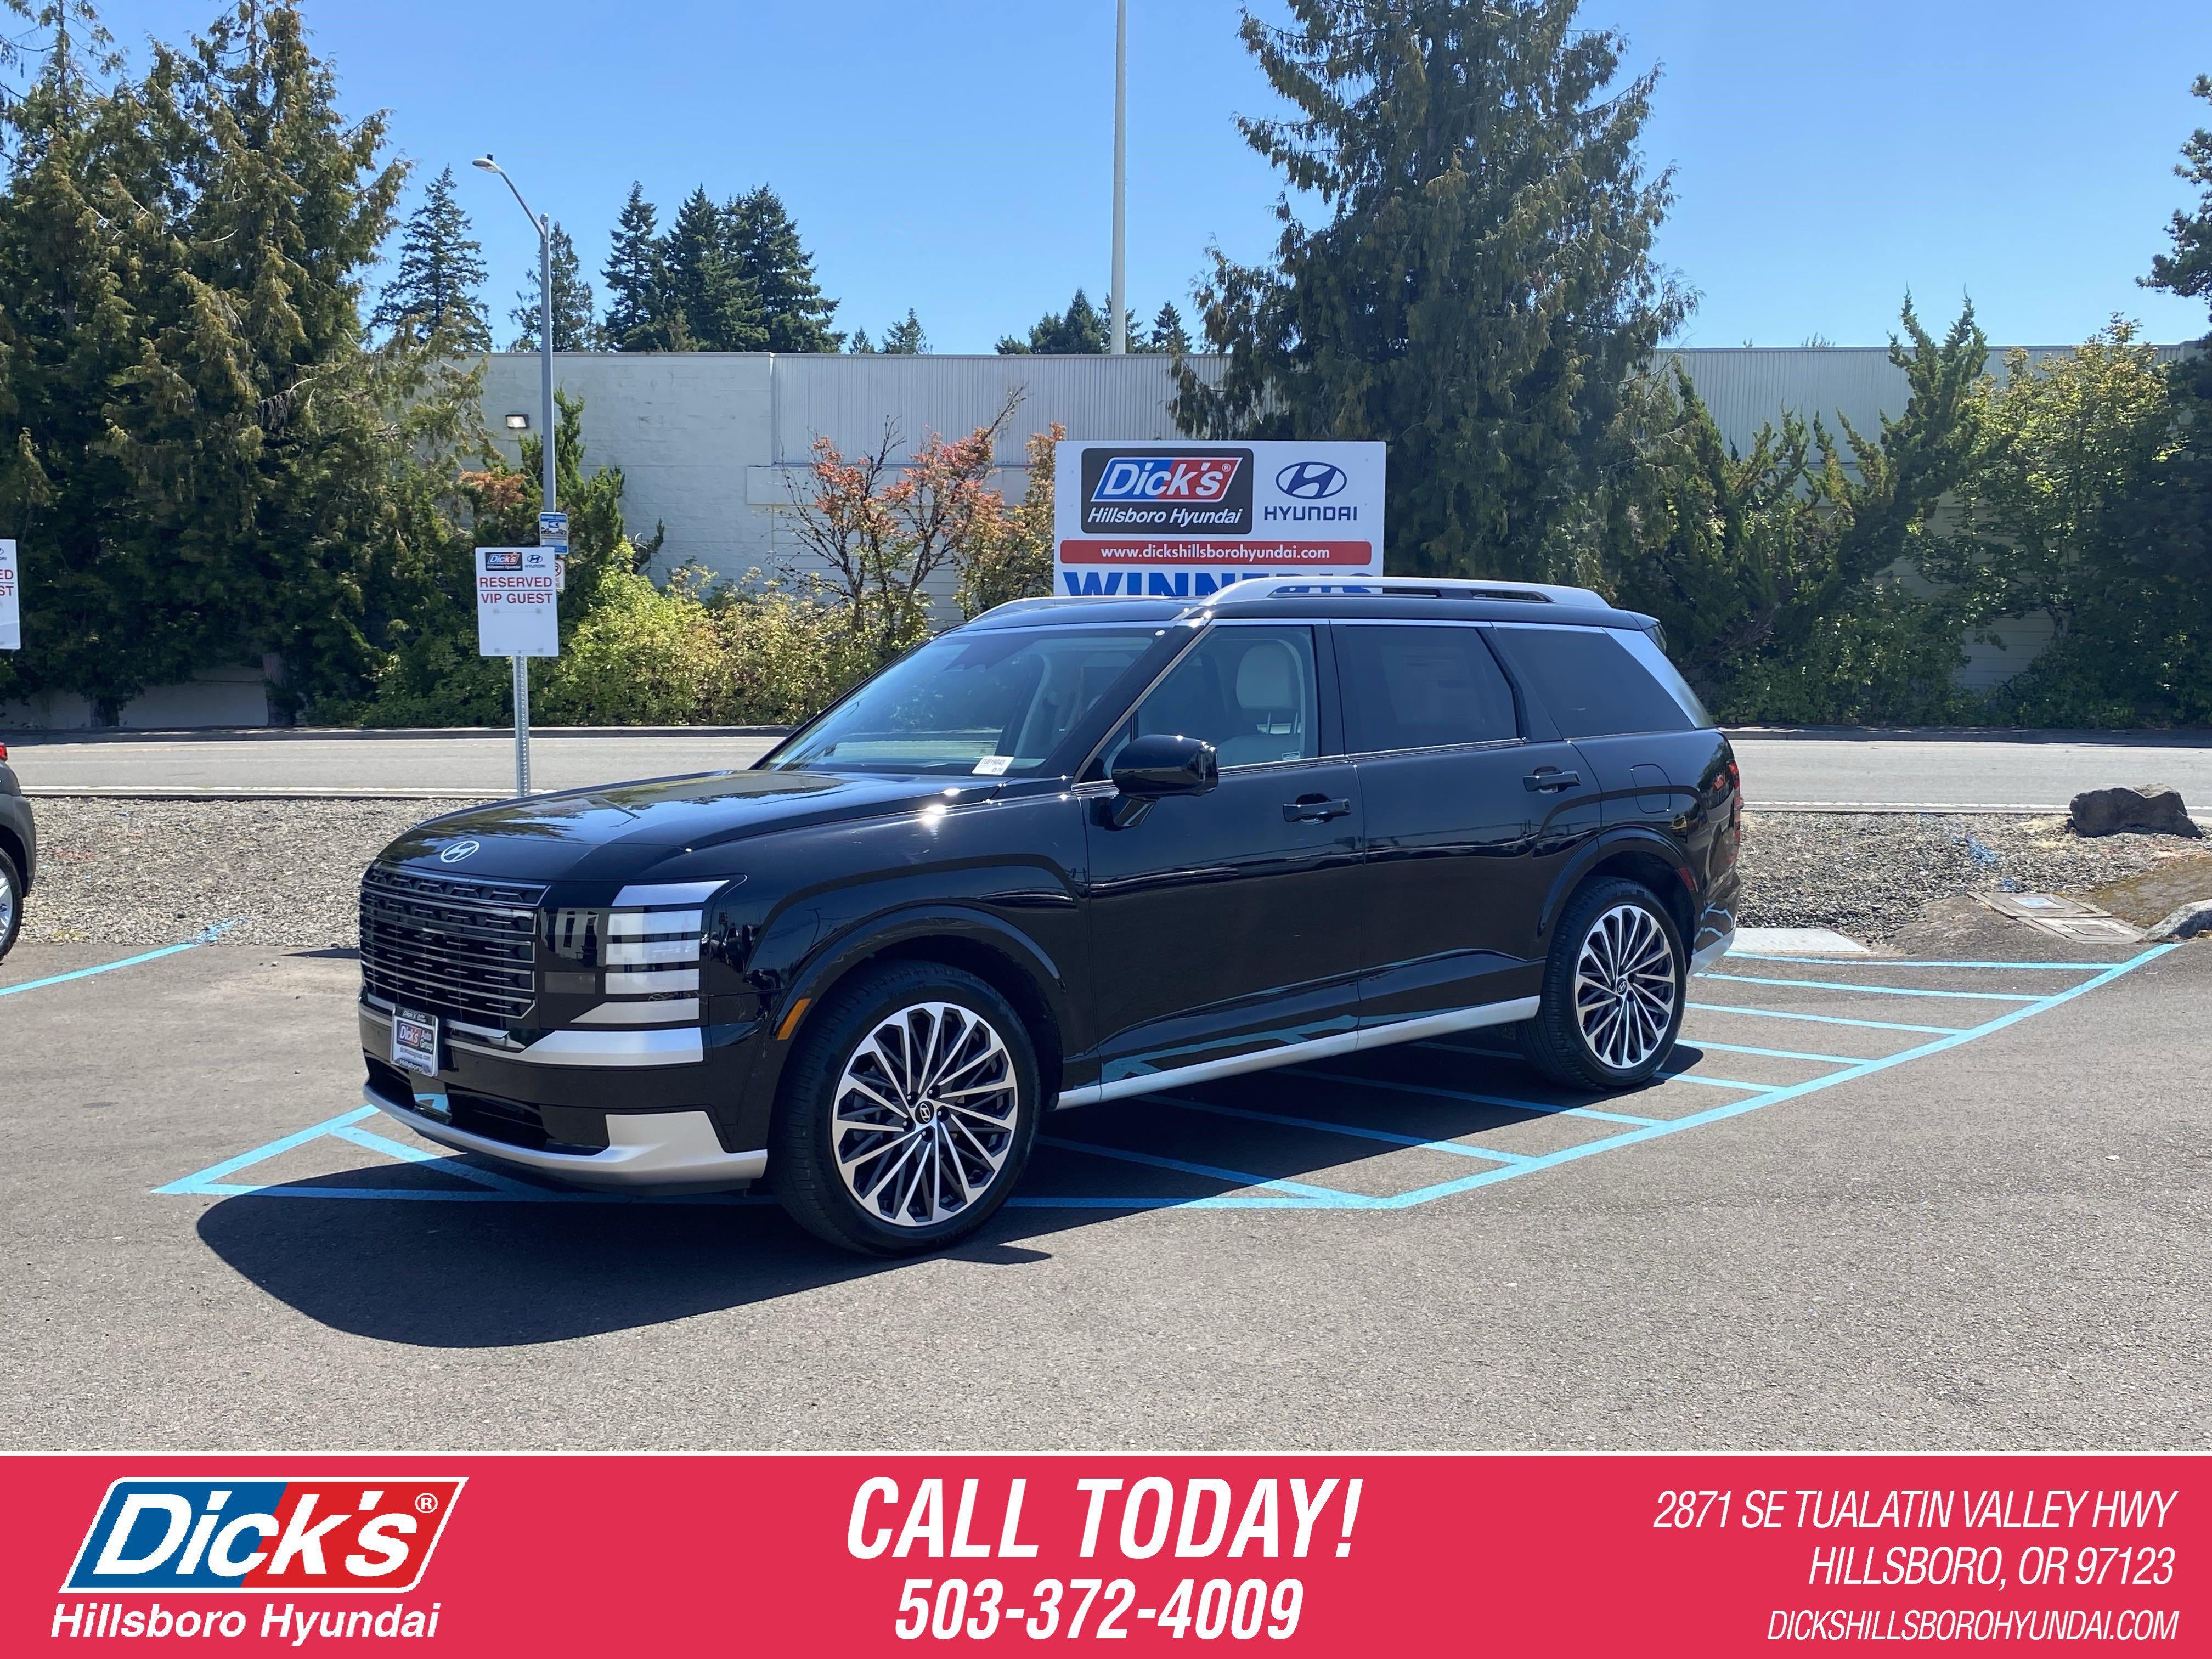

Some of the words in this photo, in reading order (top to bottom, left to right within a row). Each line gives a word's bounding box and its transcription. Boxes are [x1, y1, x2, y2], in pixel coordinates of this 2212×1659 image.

[1087, 507, 1167, 523] Hillsboro
[1169, 508, 1243, 527] Hyundai
[1264, 506, 1357, 521] HYUNDAI
[1101, 544, 1330, 562] www.dickshillsborohyundai.com
[479, 577, 552, 588] RESERVED
[481, 593, 503, 604] VIP
[506, 593, 553, 604] GUEST
